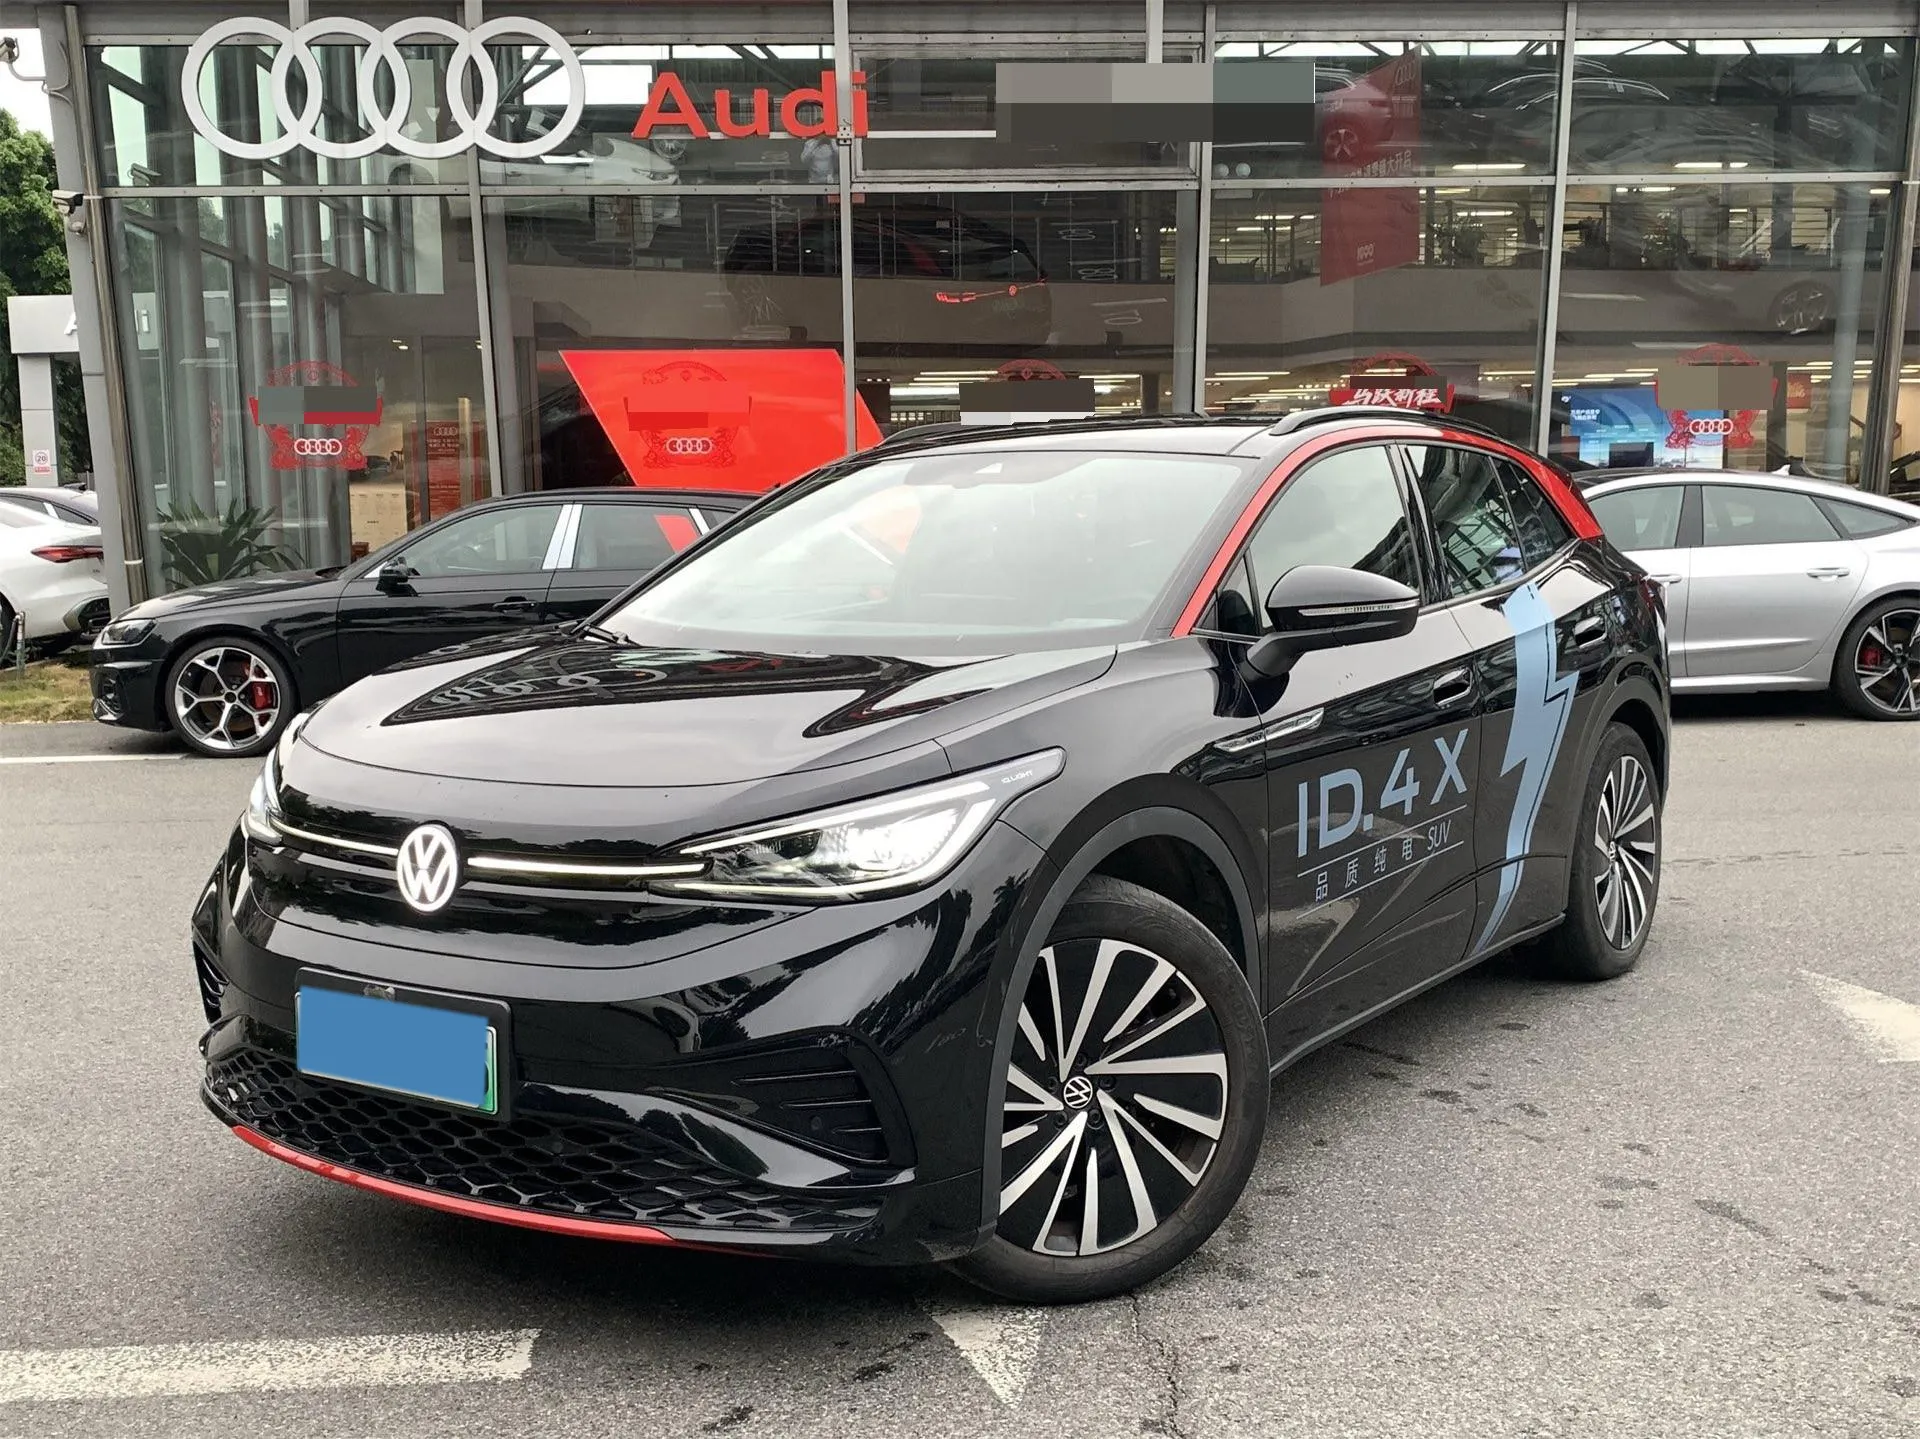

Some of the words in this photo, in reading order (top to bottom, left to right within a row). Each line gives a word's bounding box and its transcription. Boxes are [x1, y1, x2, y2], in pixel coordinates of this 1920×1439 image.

[632, 71, 868, 139] Audi
[1430, 728, 1469, 806] X
[1315, 837, 1413, 902] 品质纯电
[1427, 819, 1452, 851] SUV
